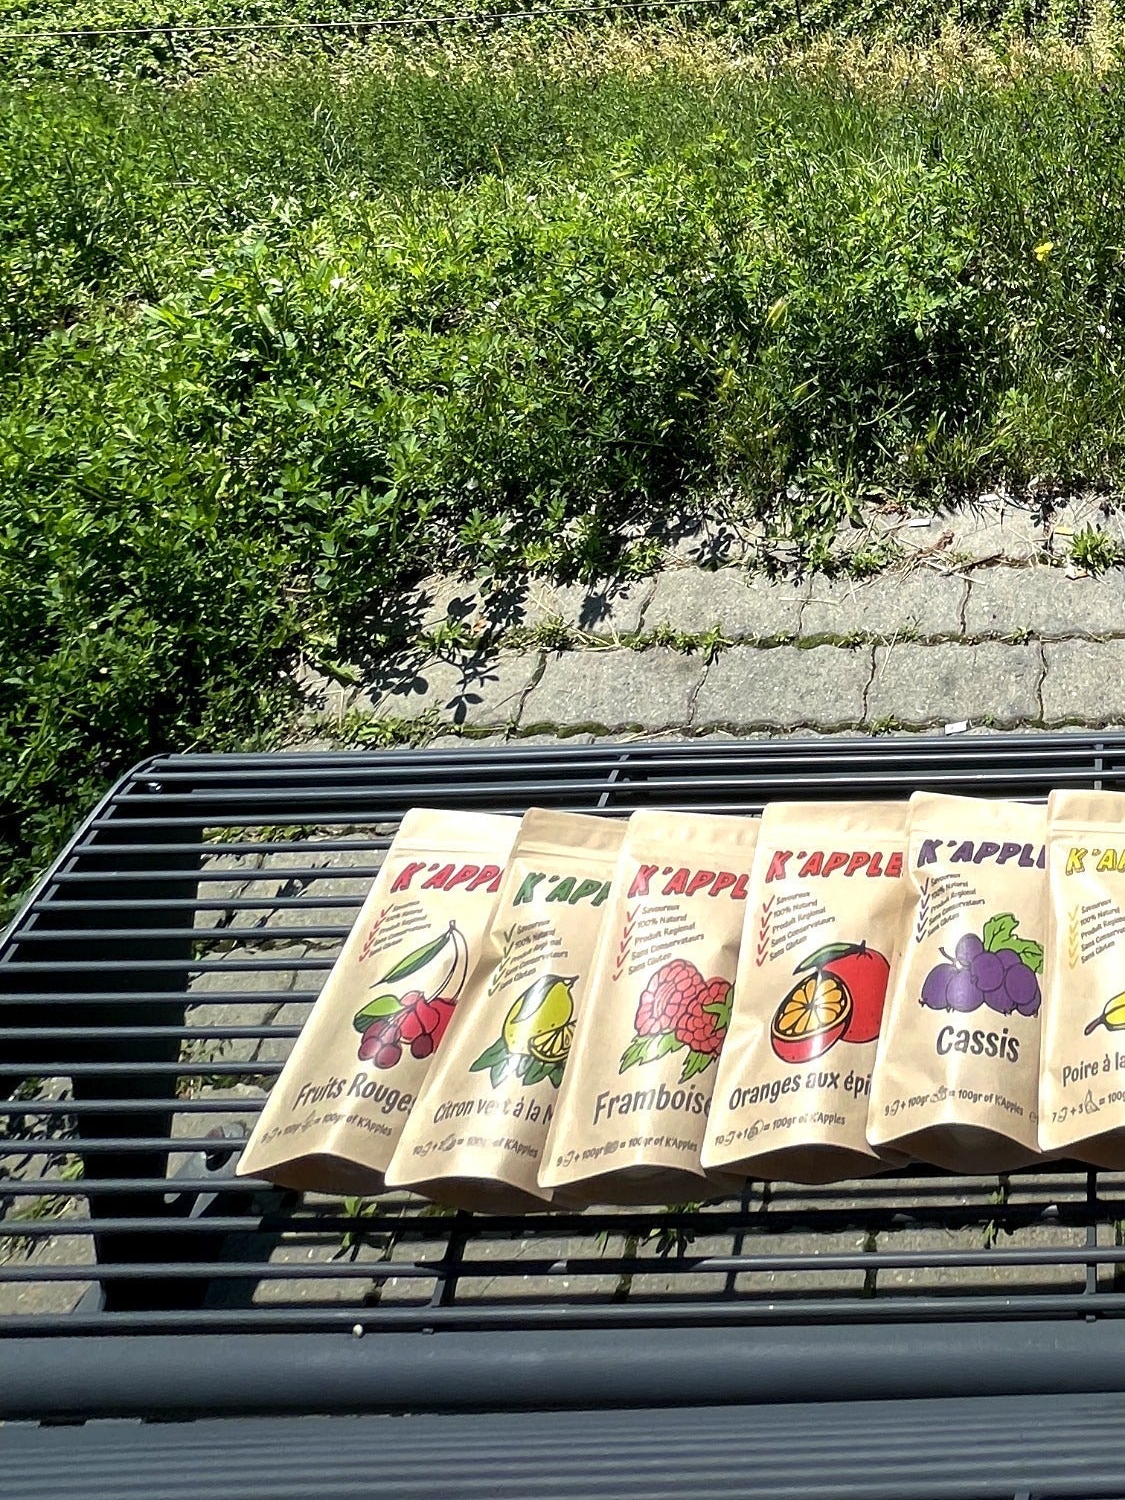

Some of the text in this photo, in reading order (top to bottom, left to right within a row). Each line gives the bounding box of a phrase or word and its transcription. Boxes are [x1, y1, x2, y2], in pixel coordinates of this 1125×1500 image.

[627, 864, 749, 900] K'APPL
[765, 851, 903, 883] K'APPLE
[936, 1025, 1020, 1063] Cassis
[1062, 1060, 1099, 1088] Poire
[1102, 1053, 1111, 1073] à
[292, 1076, 347, 1112] Fruits
[728, 1069, 872, 1111] Oranges aux épi
[908, 1094, 930, 1108] 100gr
[958, 1089, 983, 1104] 100gr
[984, 1092, 994, 1103] of
[433, 1099, 474, 1124] Citron
[477, 1099, 509, 1115] vet
[513, 1096, 525, 1117] à
[525, 1099, 541, 1123] la
[773, 1116, 797, 1131] 100gr
[654, 1135, 664, 1146] of
